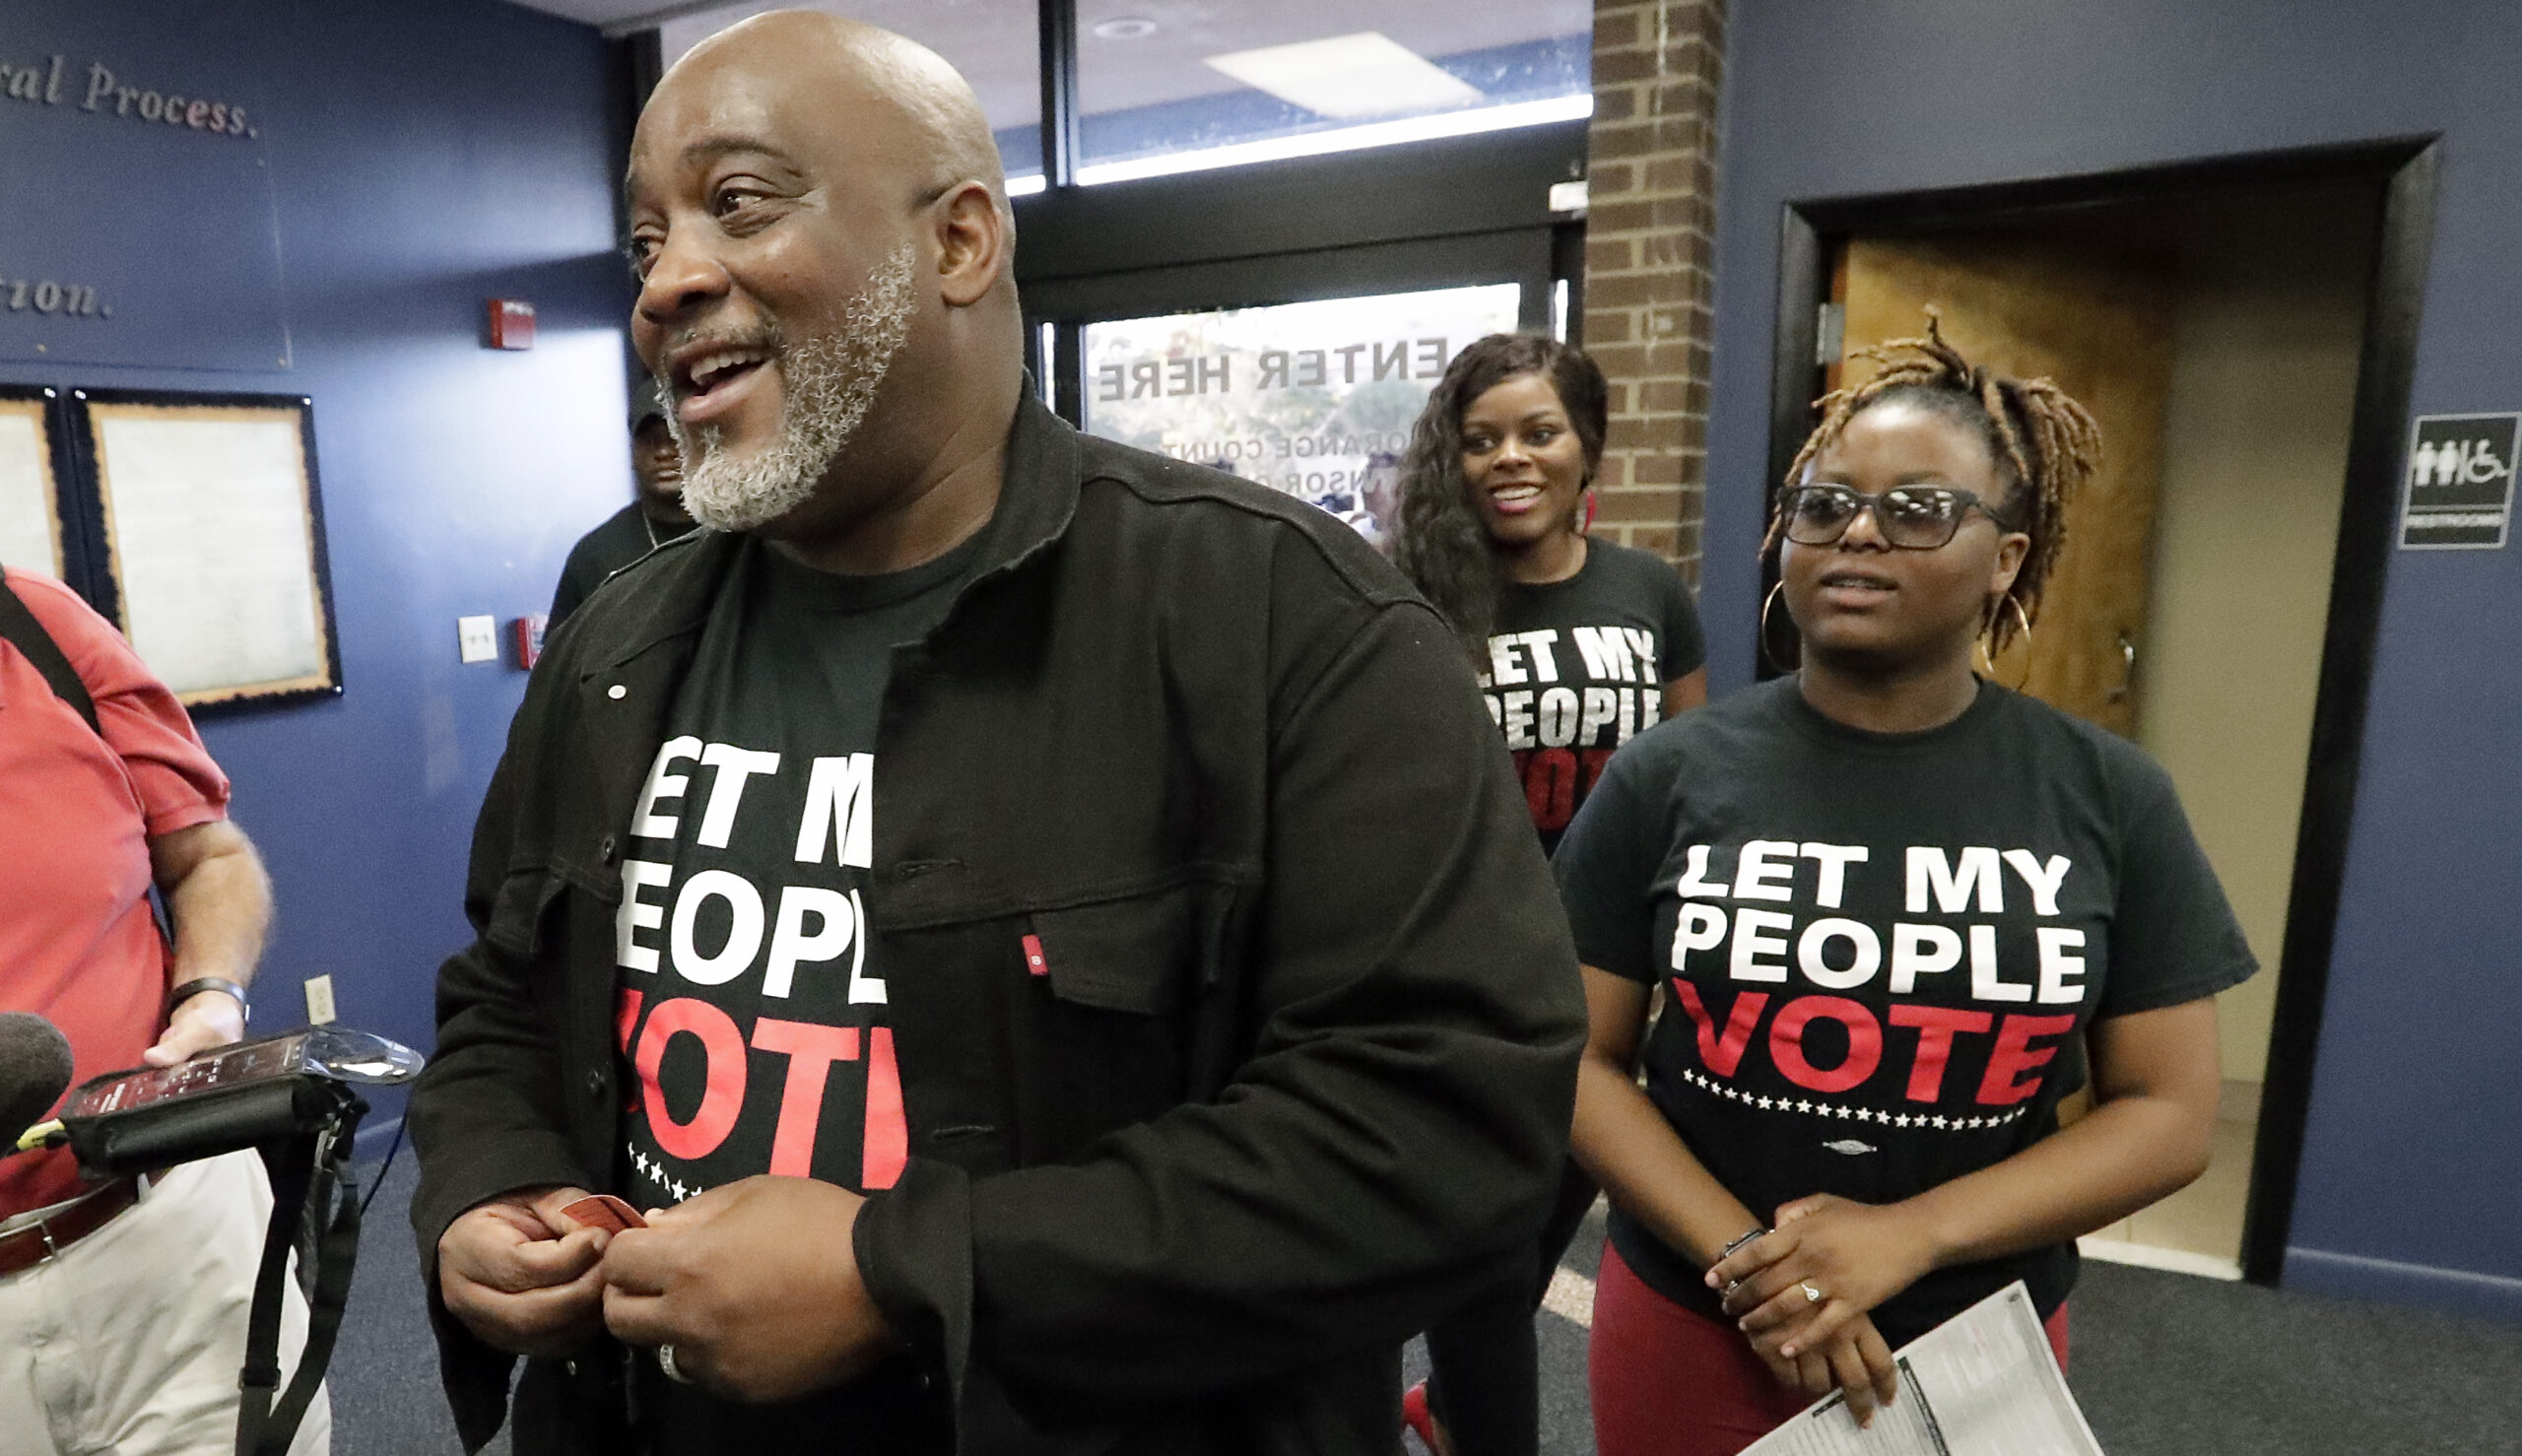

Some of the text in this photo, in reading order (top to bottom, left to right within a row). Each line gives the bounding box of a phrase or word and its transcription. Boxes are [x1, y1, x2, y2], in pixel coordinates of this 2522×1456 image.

[82, 61, 258, 140] Process.
[0, 279, 112, 317] ion.
[1572, 627, 1656, 685] MY
[630, 735, 875, 869] ET M
[1677, 840, 2071, 916] LET MY
[616, 859, 888, 1005] EOPL
[1672, 902, 2086, 1004] PEOPLE
[617, 988, 908, 1189] OT
[1672, 977, 2076, 1105] VOTE
